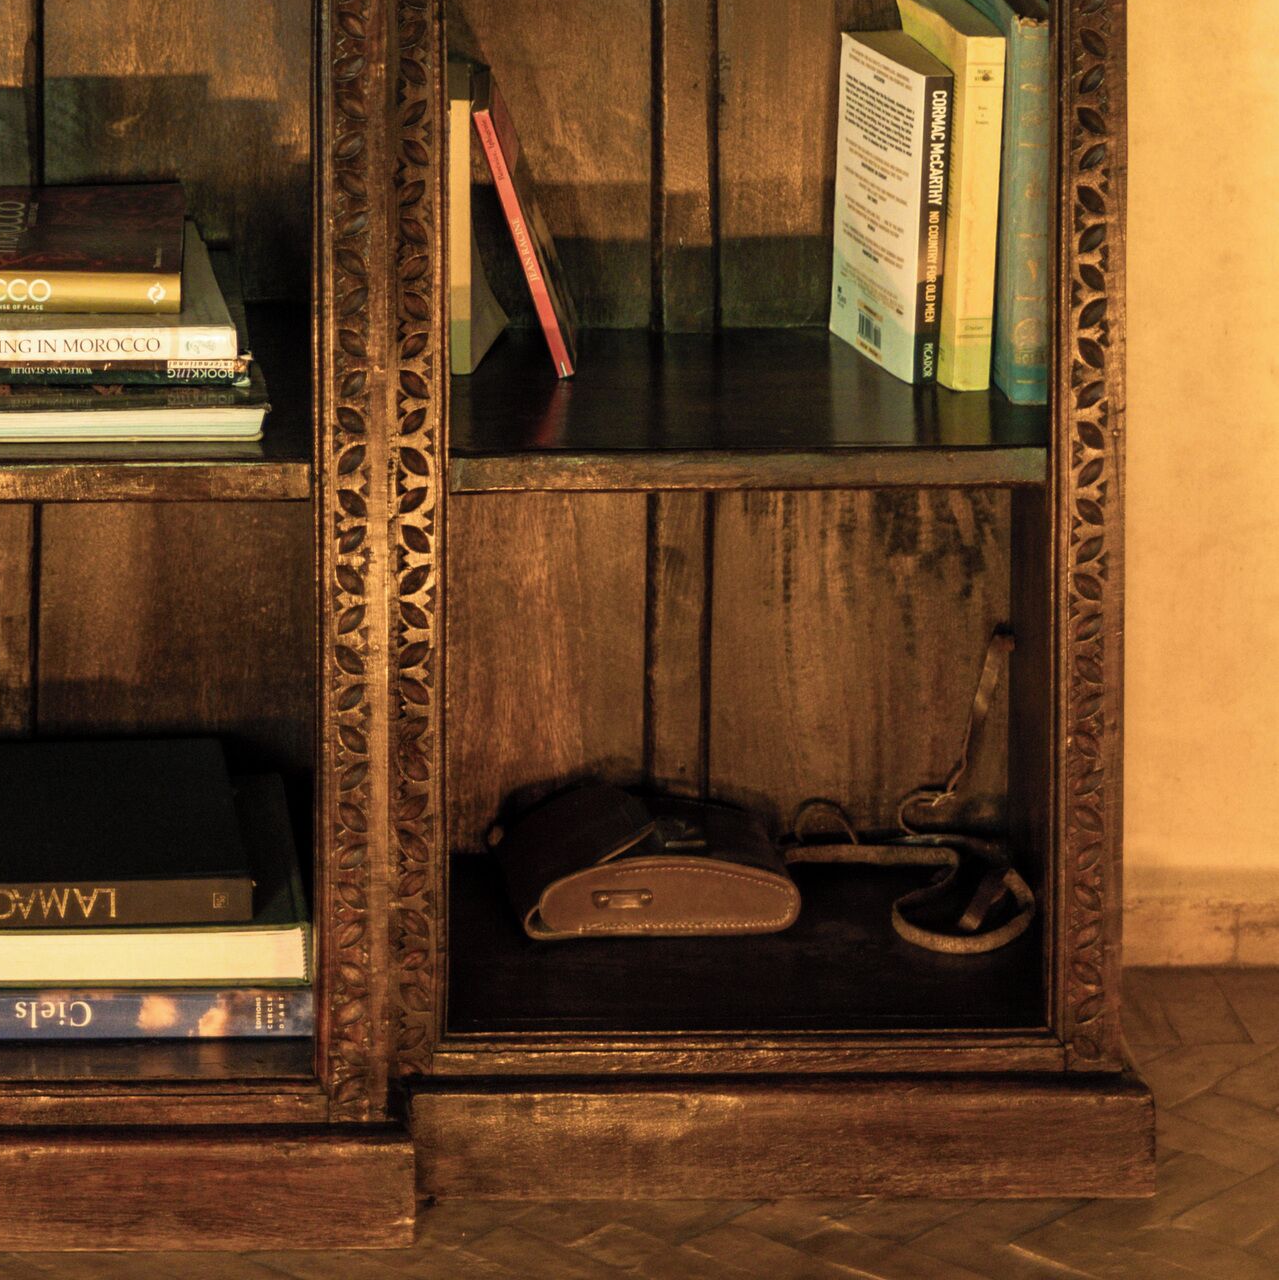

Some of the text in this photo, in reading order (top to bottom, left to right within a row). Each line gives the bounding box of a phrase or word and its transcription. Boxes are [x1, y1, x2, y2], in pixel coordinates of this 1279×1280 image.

[927, 90, 948, 206] CORMAC McCARTHY
[512, 218, 540, 282] JEAN RACINE
[924, 211, 940, 323] NO COUNTRY FOR OLD MEN
[37, 339, 57, 354] IN
[63, 336, 161, 354] MOROCCO
[922, 342, 934, 378] PICADOR
[10, 367, 93, 375] WOLFGANG STADLER
[73, 887, 117, 919] LA
[14, 1000, 93, 1029] Ciels
